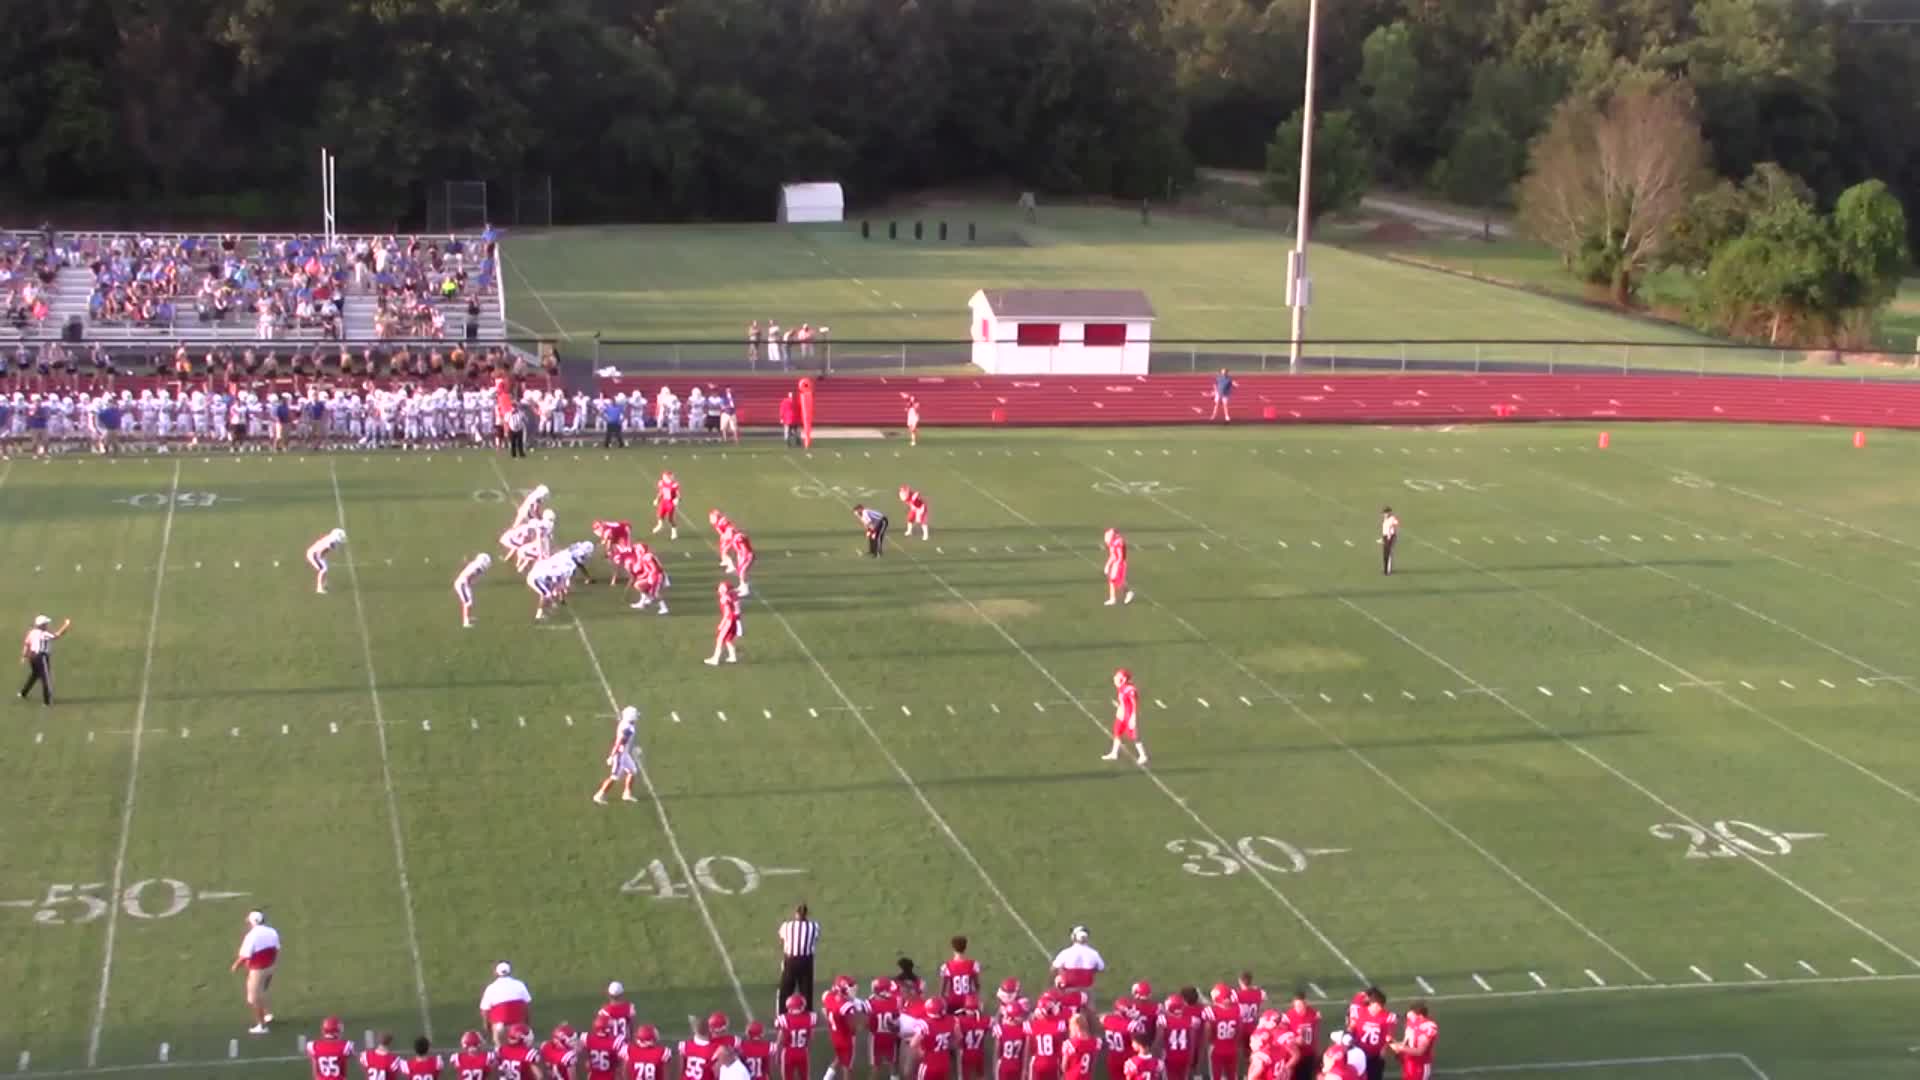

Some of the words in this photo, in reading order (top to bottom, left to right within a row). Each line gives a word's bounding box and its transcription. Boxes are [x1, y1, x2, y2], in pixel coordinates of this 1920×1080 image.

[1648, 820, 1791, 858] 20
[1165, 836, 1306, 876] 30
[621, 855, 760, 898] 40
[34, 878, 192, 924] 50
[965, 1029, 985, 1049] 47
[1036, 1034, 1054, 1056] 18
[1105, 1030, 1124, 1052] 50
[1169, 1028, 1188, 1050] 44
[1361, 1026, 1381, 1045] 76
[318, 1056, 340, 1077] 65
[634, 1063, 656, 1080] 78
[685, 1056, 706, 1080] 55
[1081, 1053, 1091, 1074] 9
